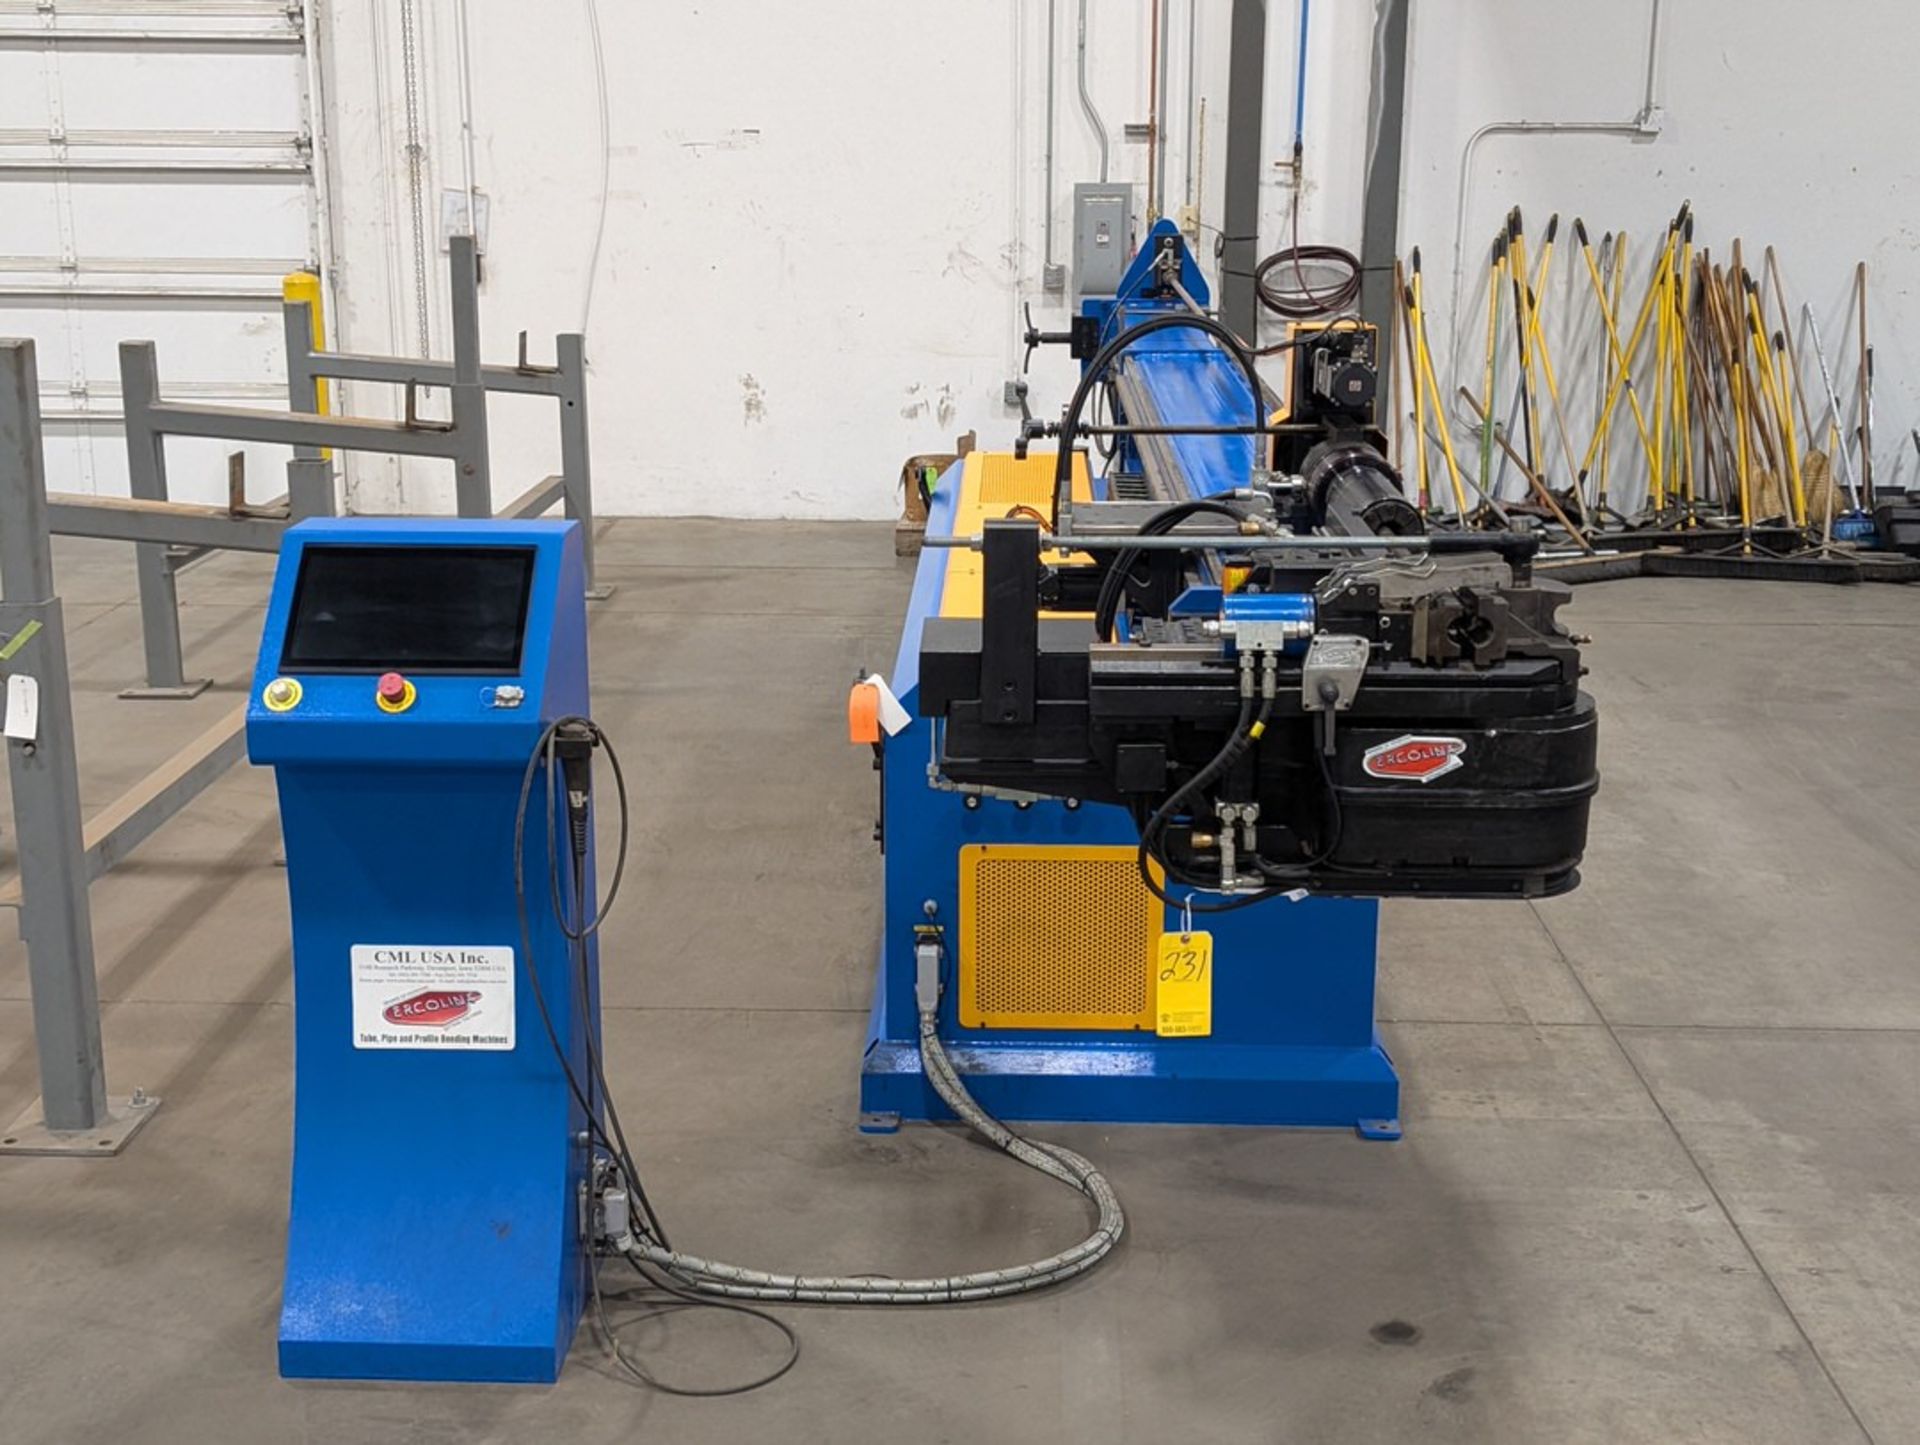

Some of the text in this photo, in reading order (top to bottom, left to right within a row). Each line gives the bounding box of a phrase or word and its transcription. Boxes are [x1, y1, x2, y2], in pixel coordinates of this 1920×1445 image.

[374, 950, 489, 964] CML USA Inc.
[1160, 949, 1207, 981] 231
[360, 1033, 378, 1043] Tube,
[381, 1033, 398, 1044] Pipe
[400, 1034, 413, 1043] and
[440, 1034, 470, 1045] Bending
[472, 1034, 508, 1044] Machines
